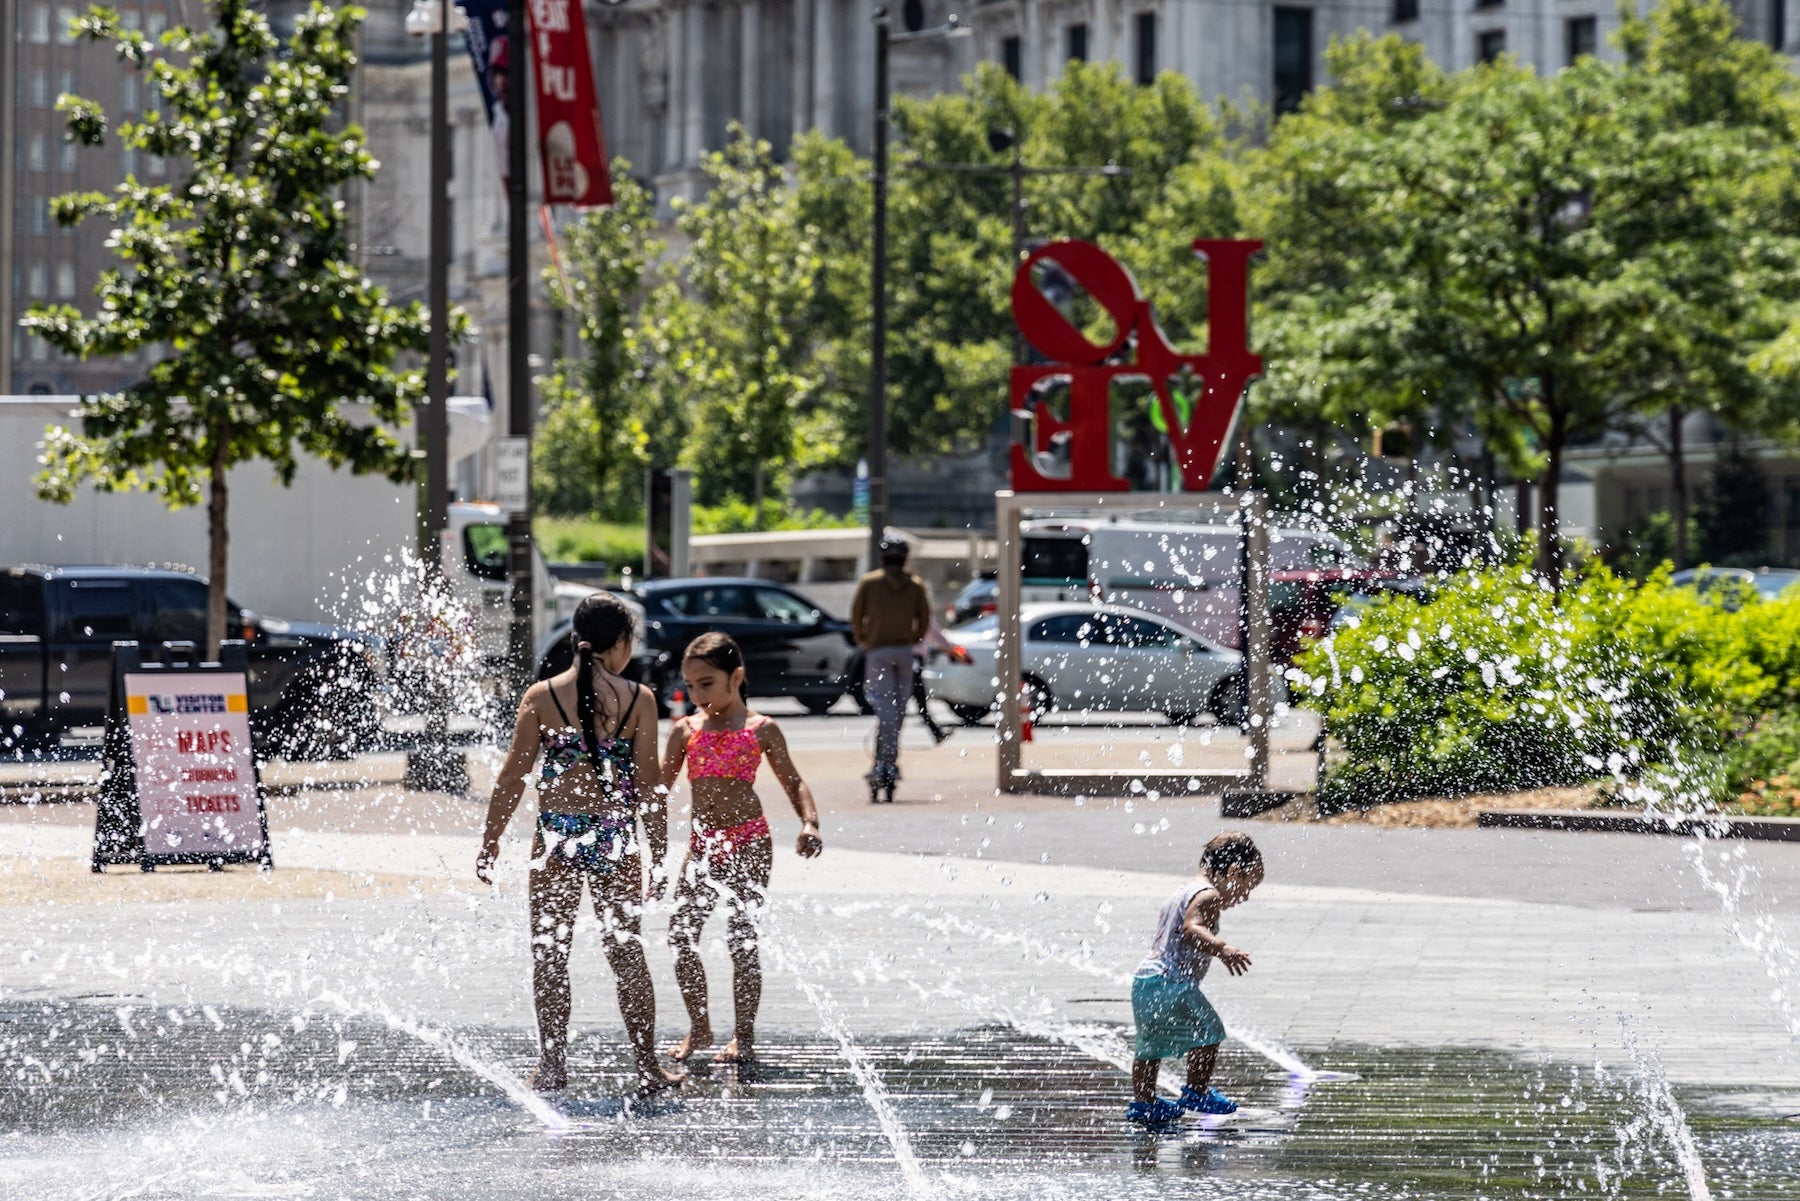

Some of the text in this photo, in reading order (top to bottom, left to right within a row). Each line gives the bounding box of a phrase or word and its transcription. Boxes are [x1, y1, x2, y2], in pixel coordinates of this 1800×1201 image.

[175, 694, 225, 703] VISITOR
[176, 704, 226, 713] CENTER
[178, 730, 232, 754] MAPS
[186, 795, 241, 813] TICKETS
